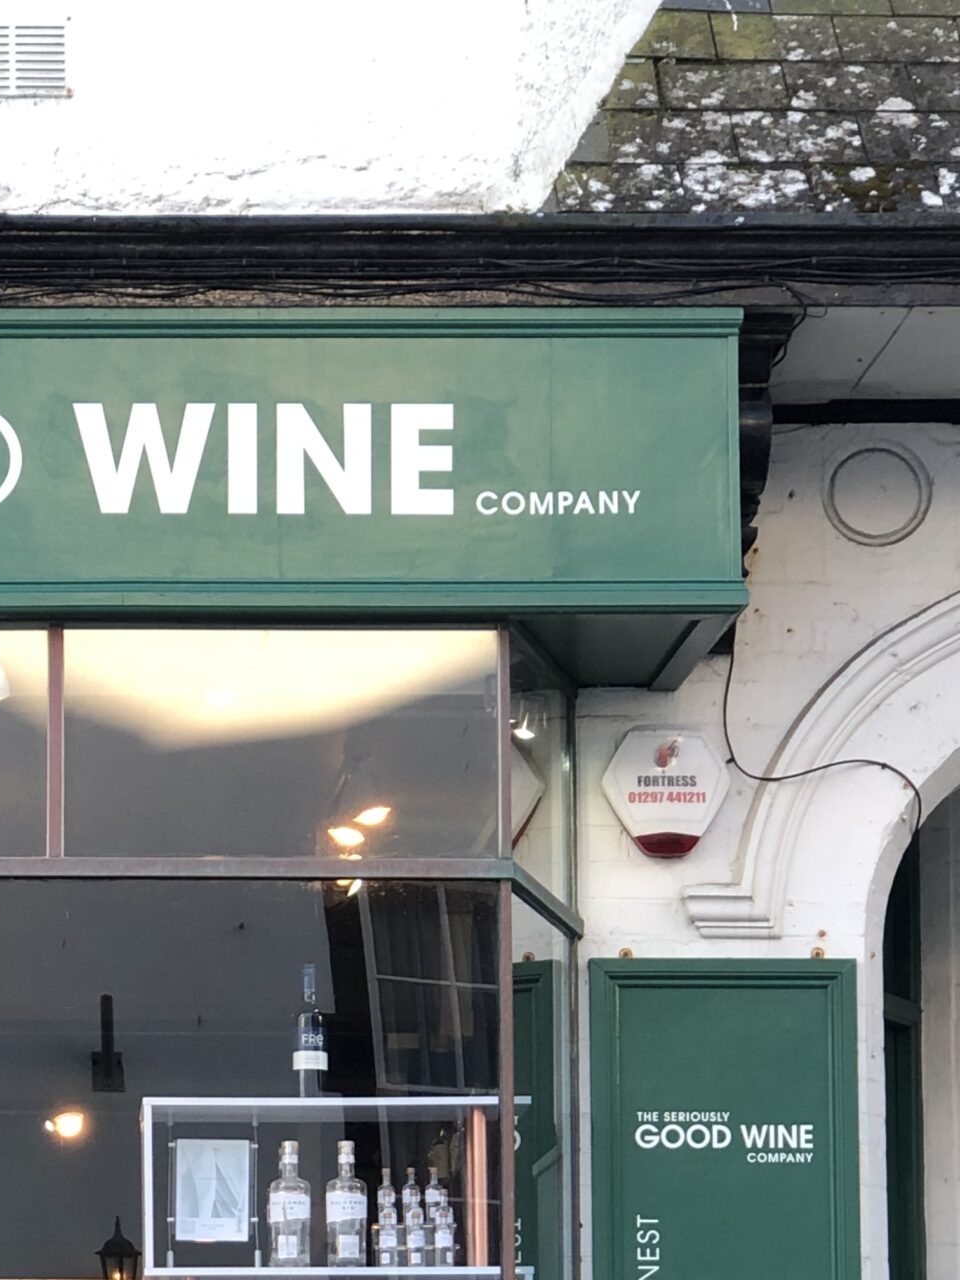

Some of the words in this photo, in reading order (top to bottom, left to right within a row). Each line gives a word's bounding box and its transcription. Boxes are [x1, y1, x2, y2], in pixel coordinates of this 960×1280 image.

[73, 402, 454, 516] WINE
[476, 490, 641, 516] COMPANY
[637, 775, 697, 787] FORTRESS
[628, 792, 664, 804] 01297
[667, 792, 706, 804] 441211
[636, 1111, 659, 1122] THE
[663, 1111, 730, 1122] SERIOUSLY
[634, 1124, 732, 1149] GOOD
[740, 1124, 814, 1149] WINE
[746, 1152, 814, 1163] COMPANY
